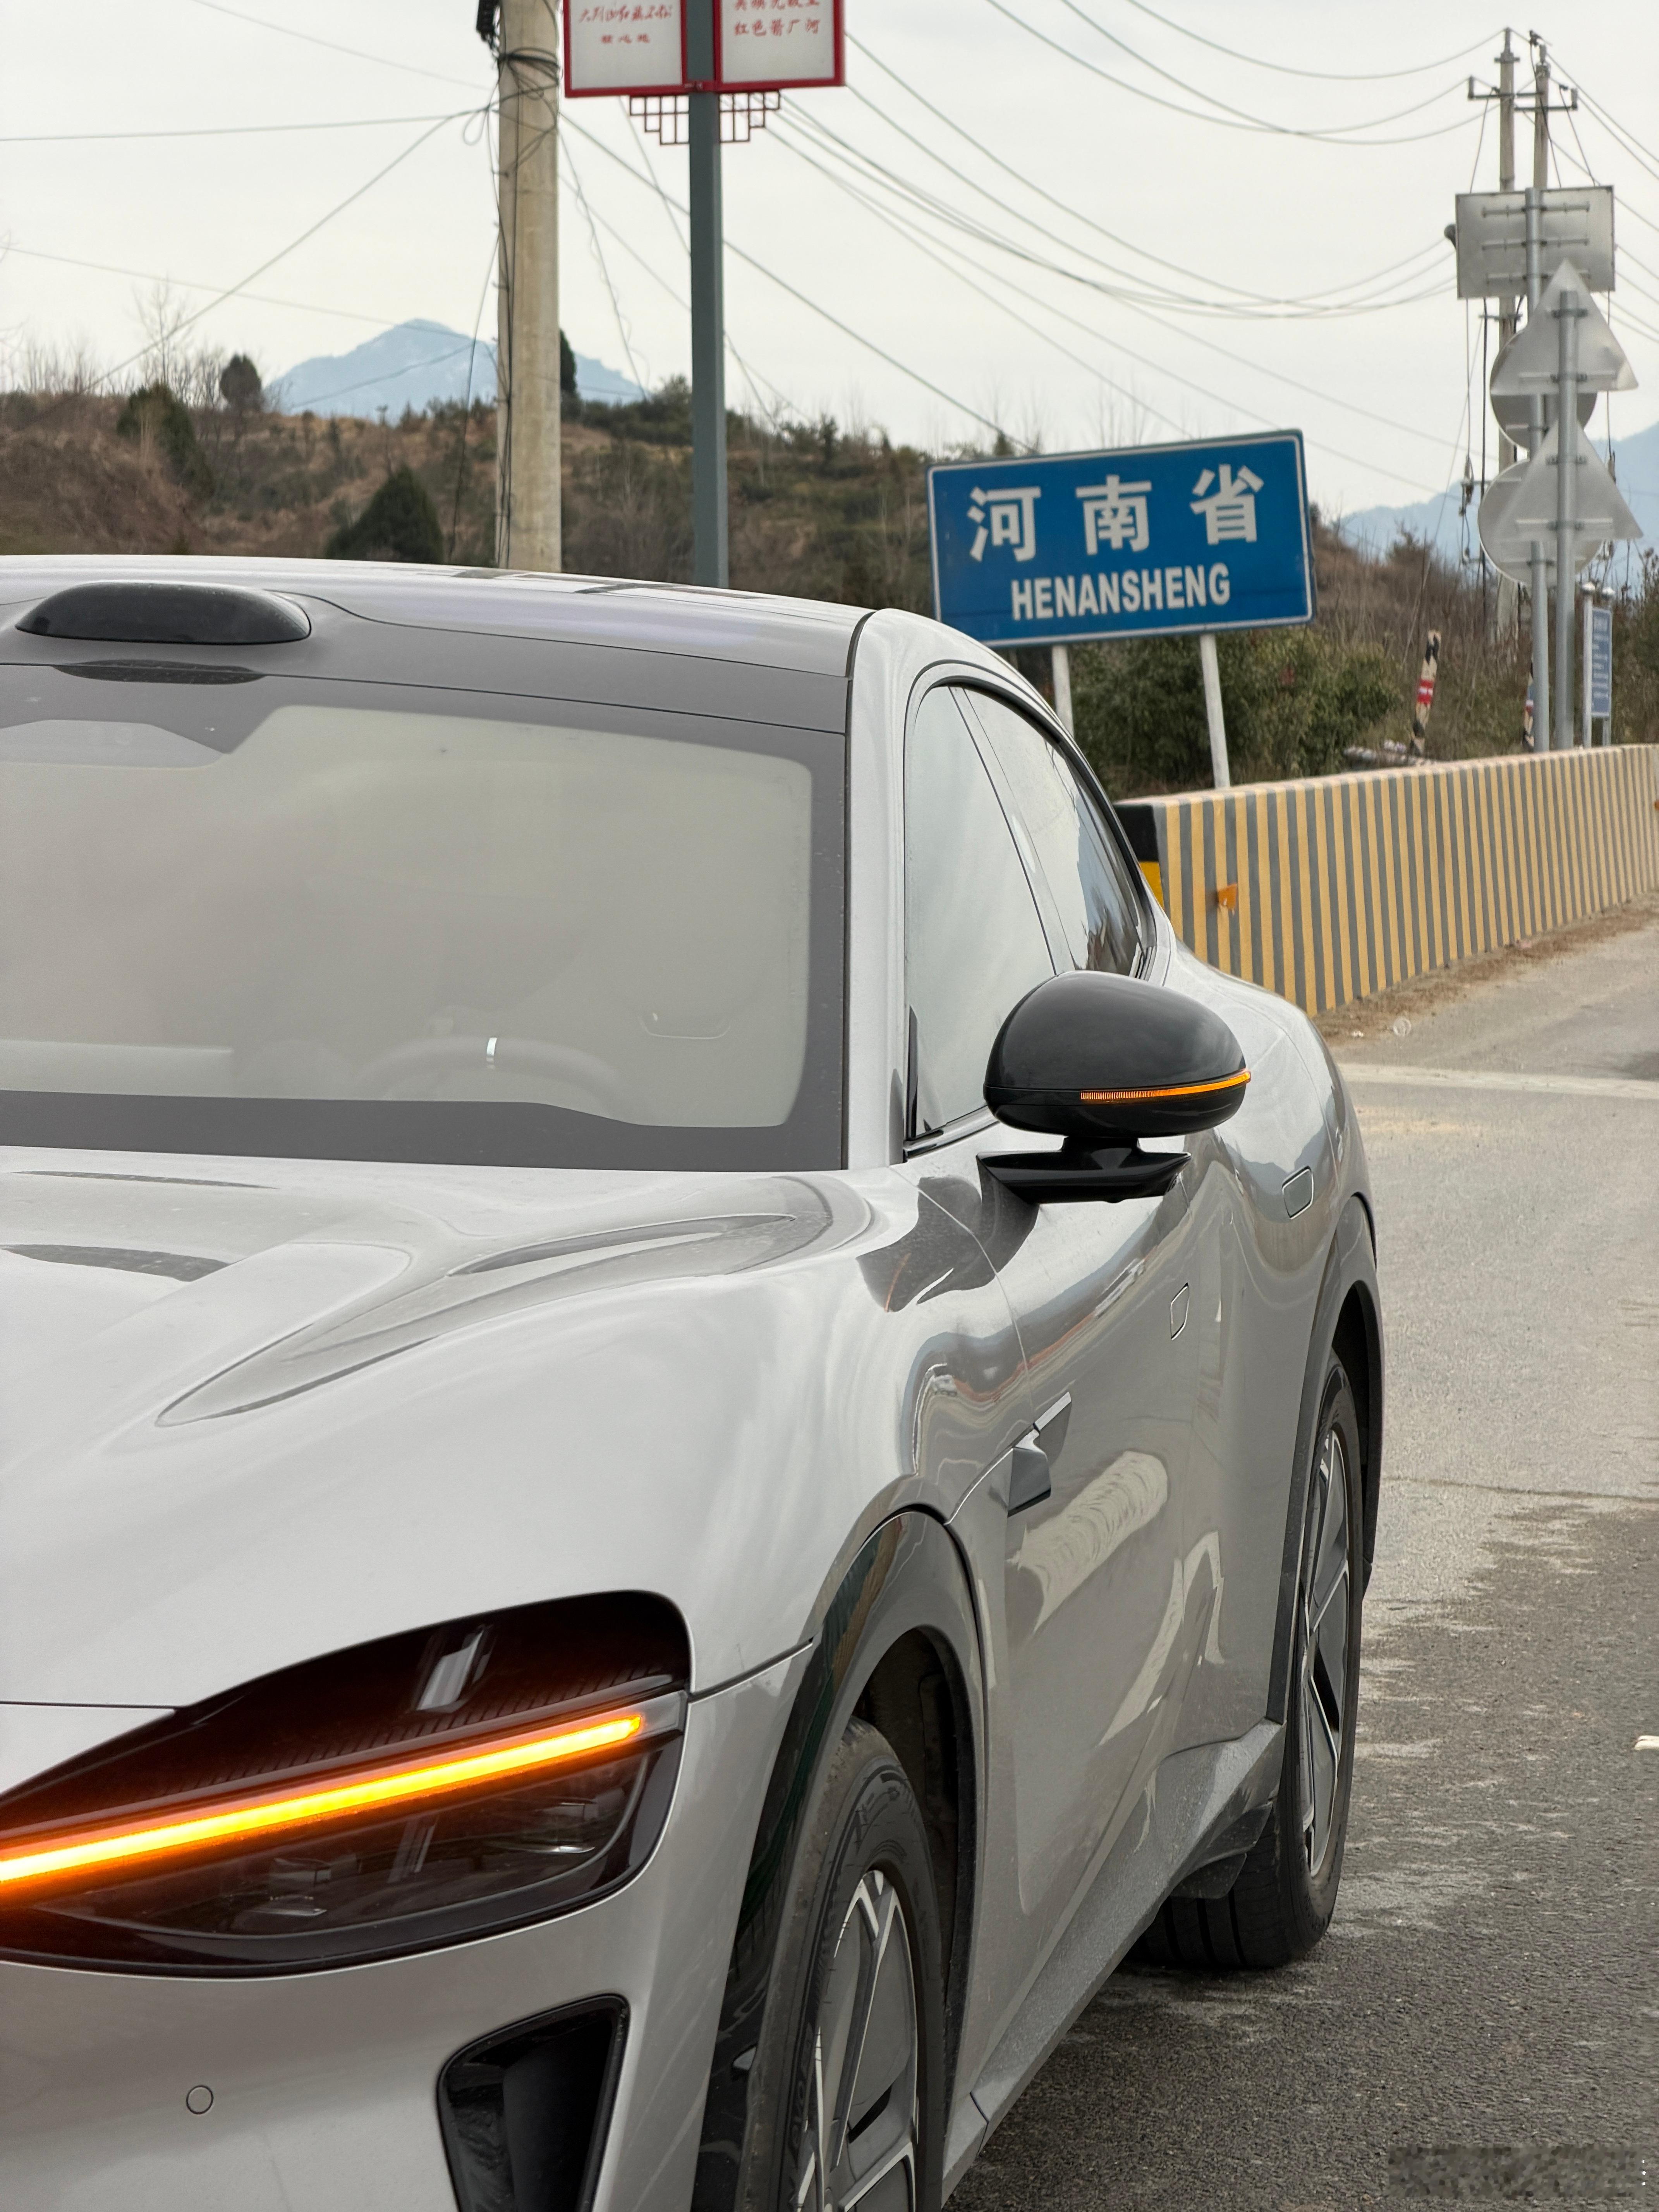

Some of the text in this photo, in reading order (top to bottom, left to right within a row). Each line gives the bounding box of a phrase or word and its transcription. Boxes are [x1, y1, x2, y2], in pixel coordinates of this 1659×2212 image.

[967, 464, 1264, 562] 河南省
[1011, 562, 1230, 620] HENANSHENG
